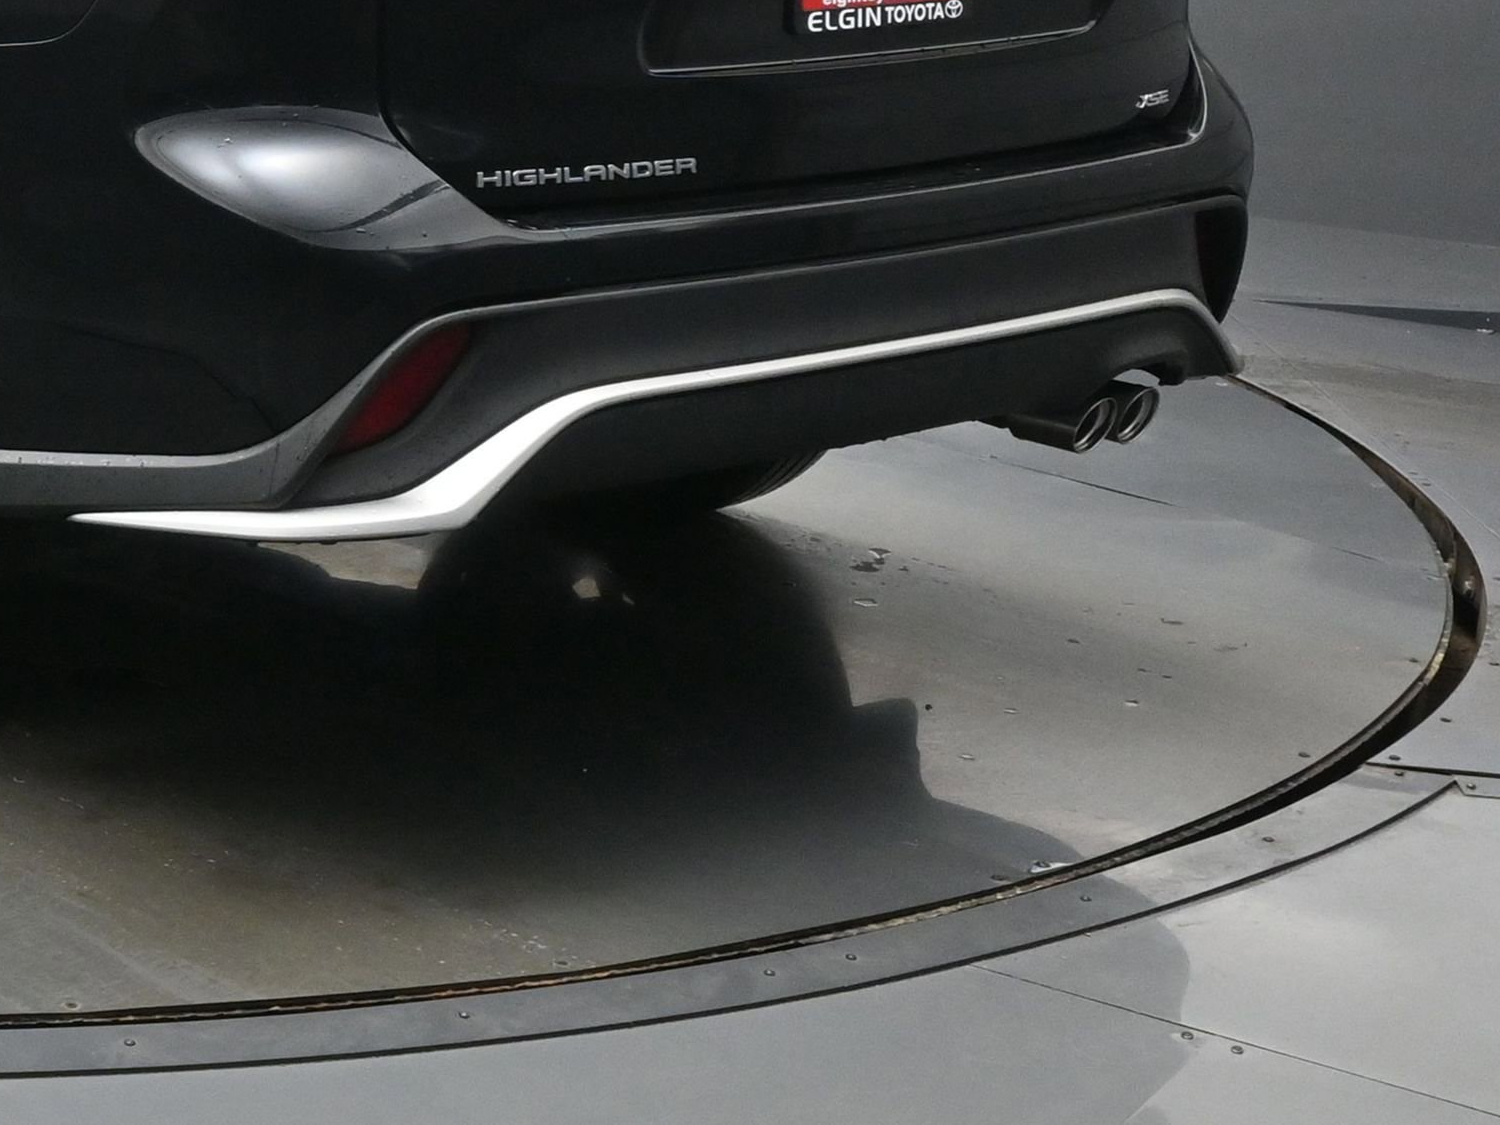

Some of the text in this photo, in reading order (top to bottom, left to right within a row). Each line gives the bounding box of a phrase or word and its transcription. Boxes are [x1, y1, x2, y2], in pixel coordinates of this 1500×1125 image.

[807, 2, 945, 32] ELGIN TOYOTA
[476, 157, 698, 189] HIGHLANDER
